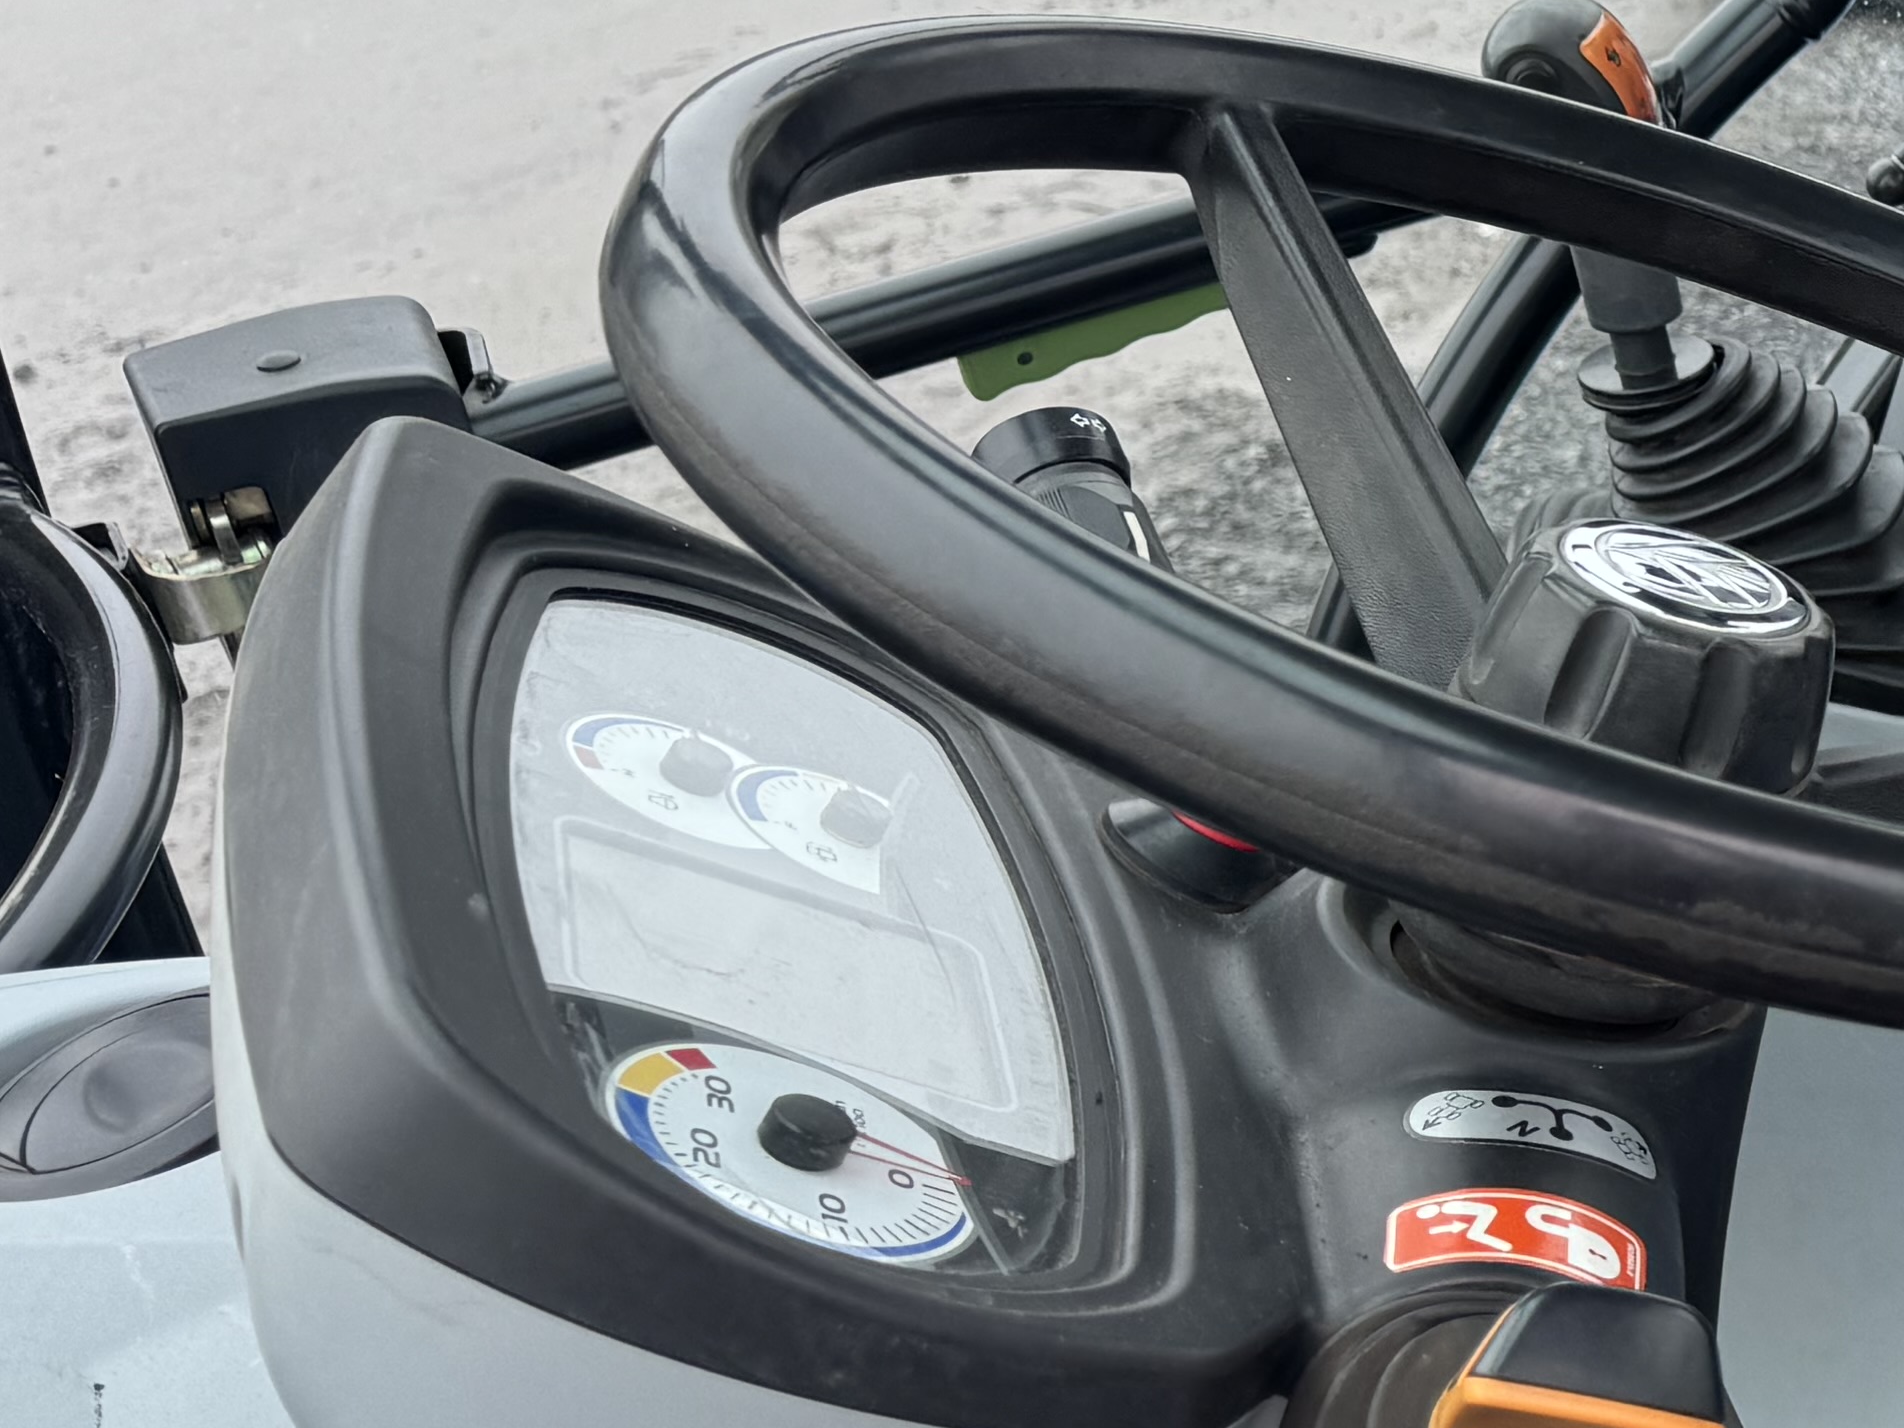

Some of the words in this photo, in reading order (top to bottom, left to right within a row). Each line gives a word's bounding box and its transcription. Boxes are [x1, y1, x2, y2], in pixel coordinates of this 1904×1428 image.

[705, 1075, 735, 1113] 30
[1506, 1119, 1541, 1138] N
[690, 1127, 721, 1168] 20
[888, 1169, 914, 1189] 0
[819, 1193, 848, 1224] 10
